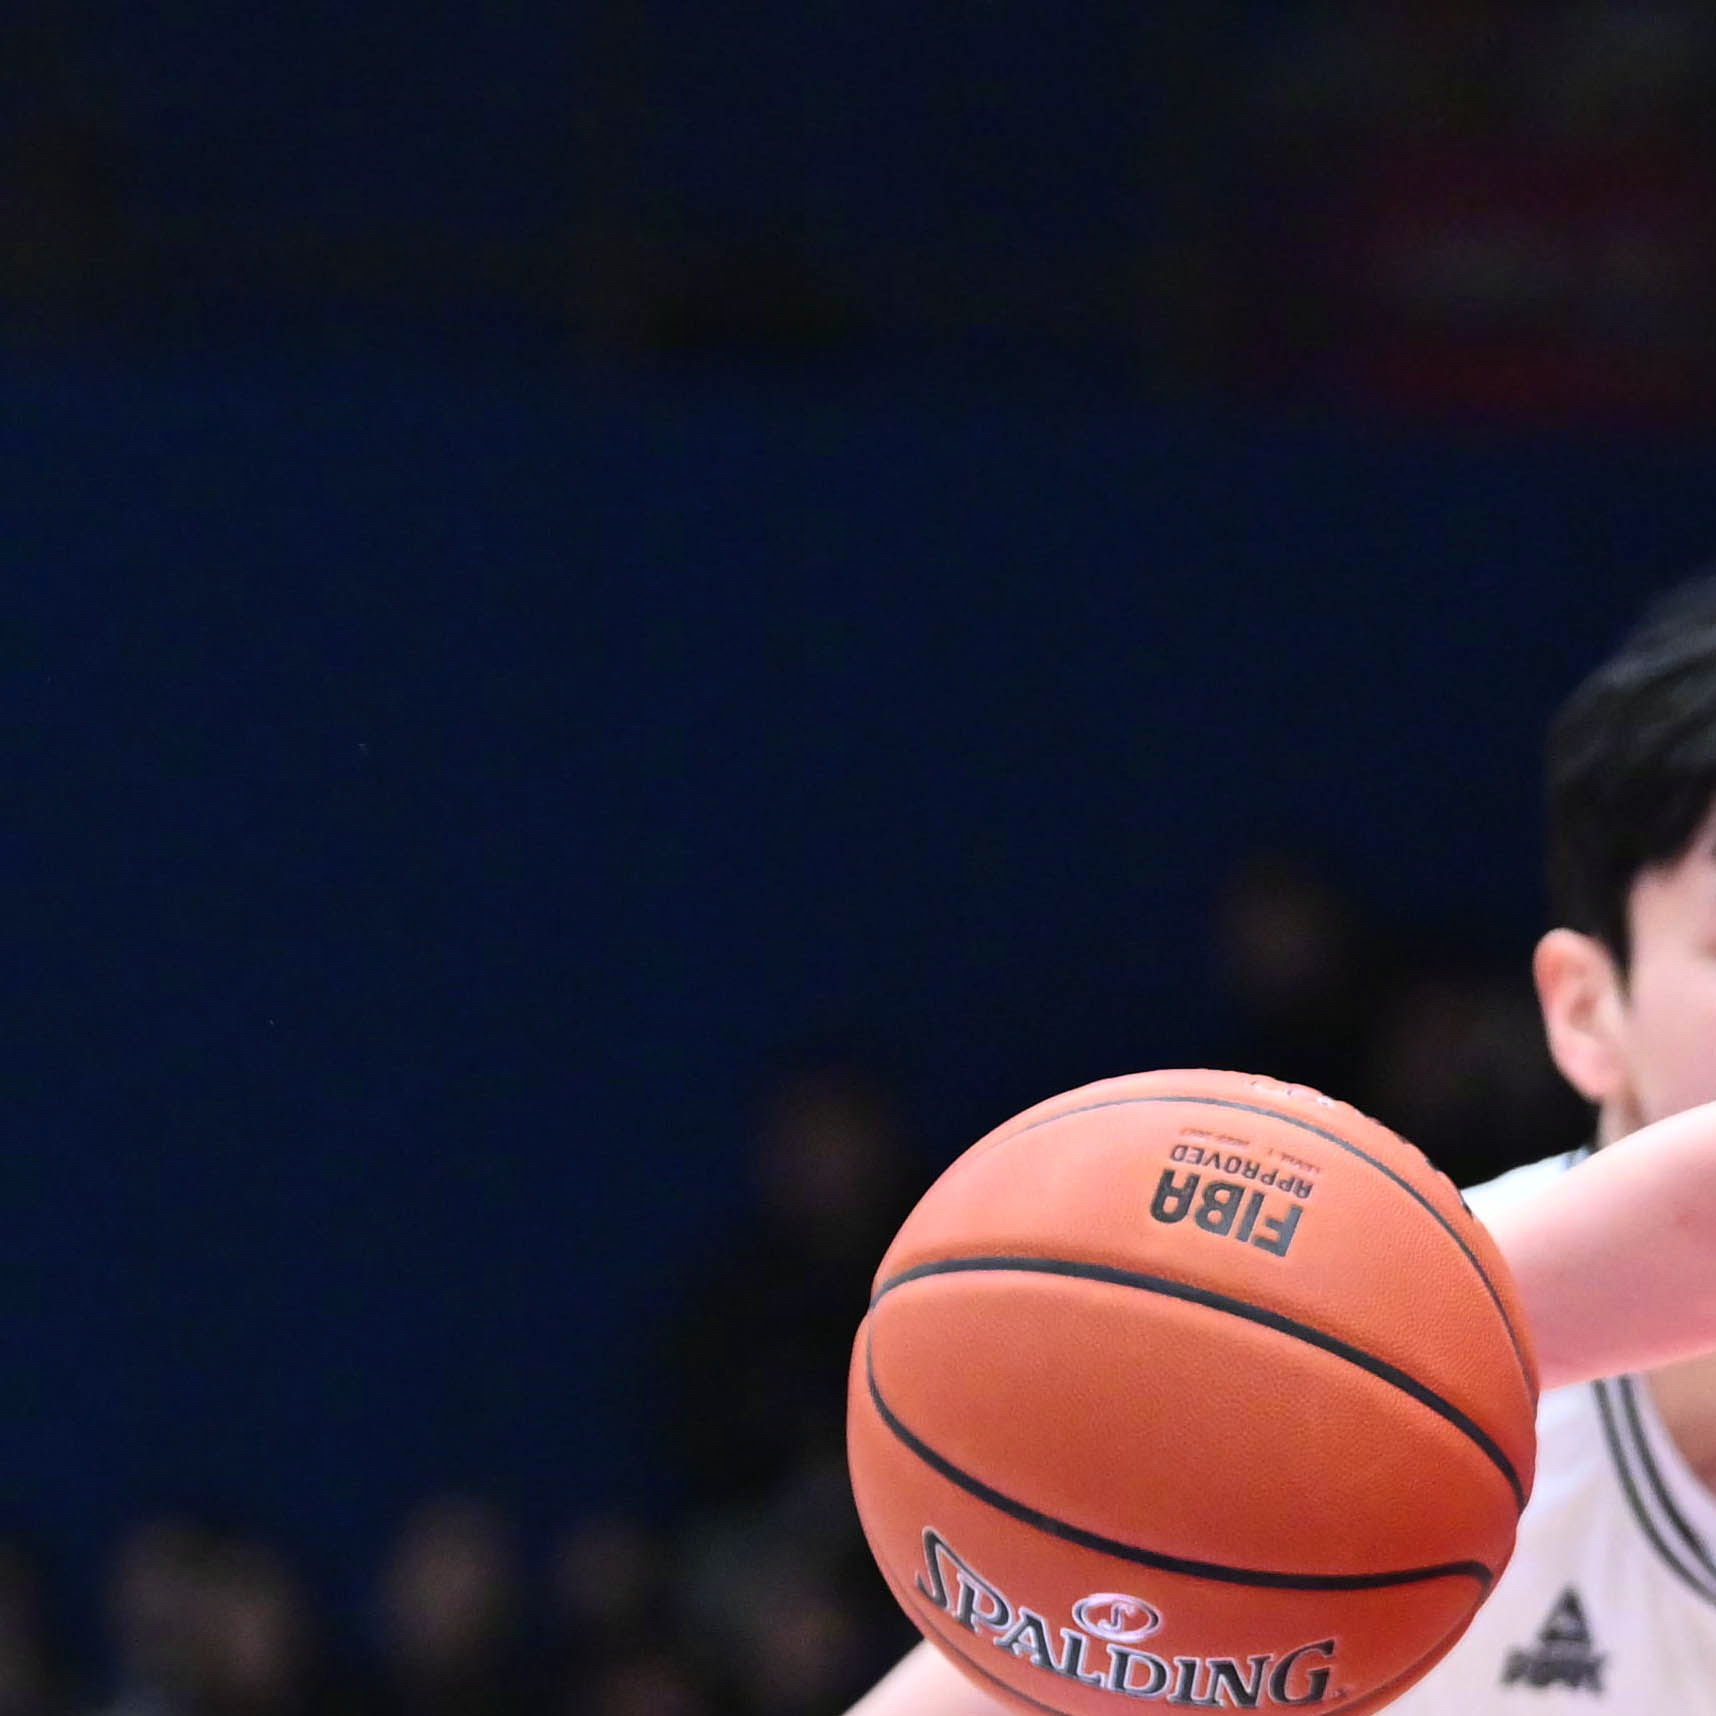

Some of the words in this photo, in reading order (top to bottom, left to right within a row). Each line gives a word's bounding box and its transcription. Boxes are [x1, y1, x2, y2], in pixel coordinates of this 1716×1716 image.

[1149, 1168, 1304, 1258] FIBA
[1169, 1144, 1314, 1200] APPROVED
[915, 1525, 1338, 1709] SPALDING
